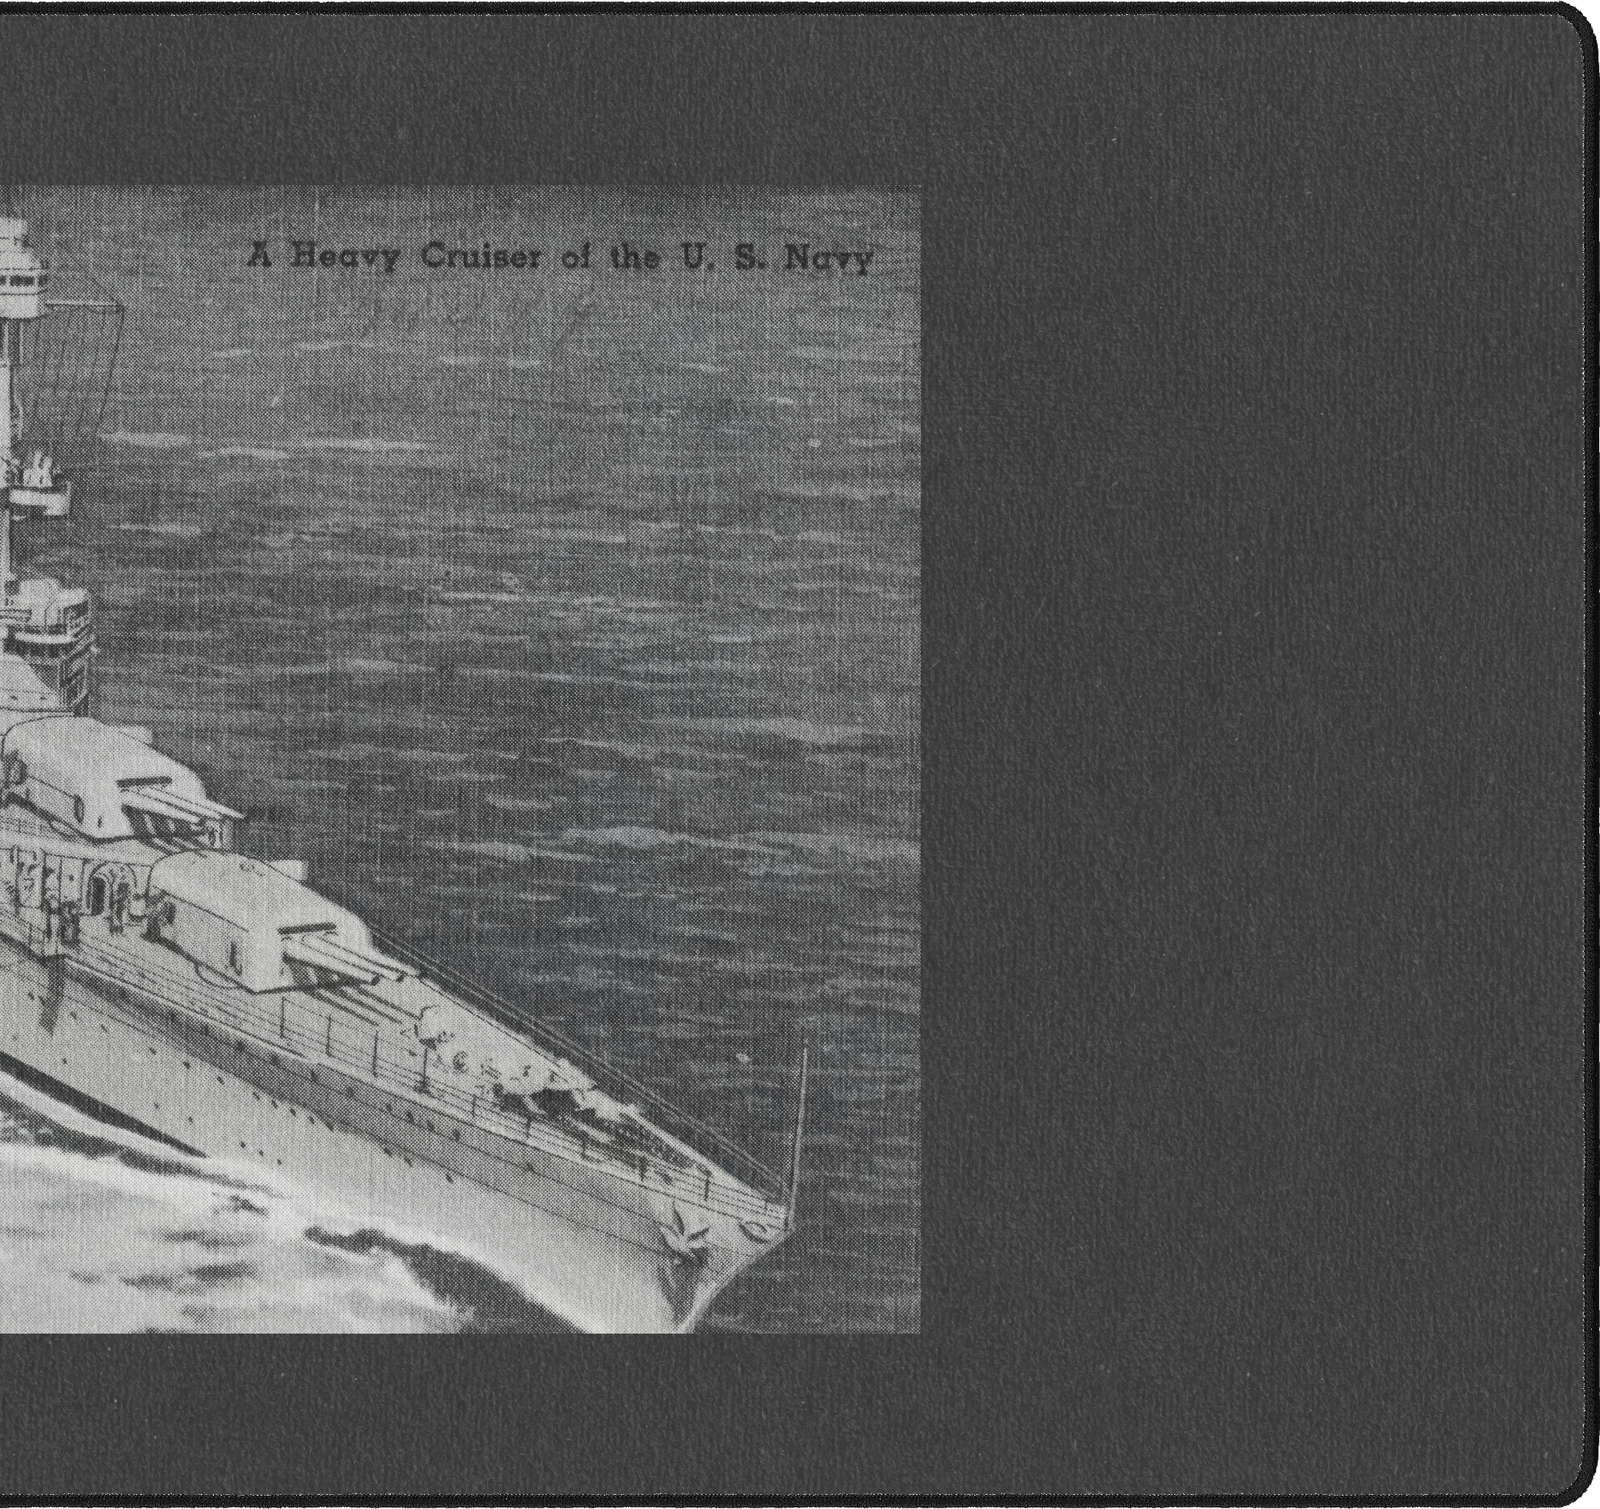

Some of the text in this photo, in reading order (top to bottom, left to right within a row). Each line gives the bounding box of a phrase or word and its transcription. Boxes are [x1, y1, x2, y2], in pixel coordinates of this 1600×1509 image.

[246, 240, 875, 277] A Heavy Cruiser of the U. S. Navy
